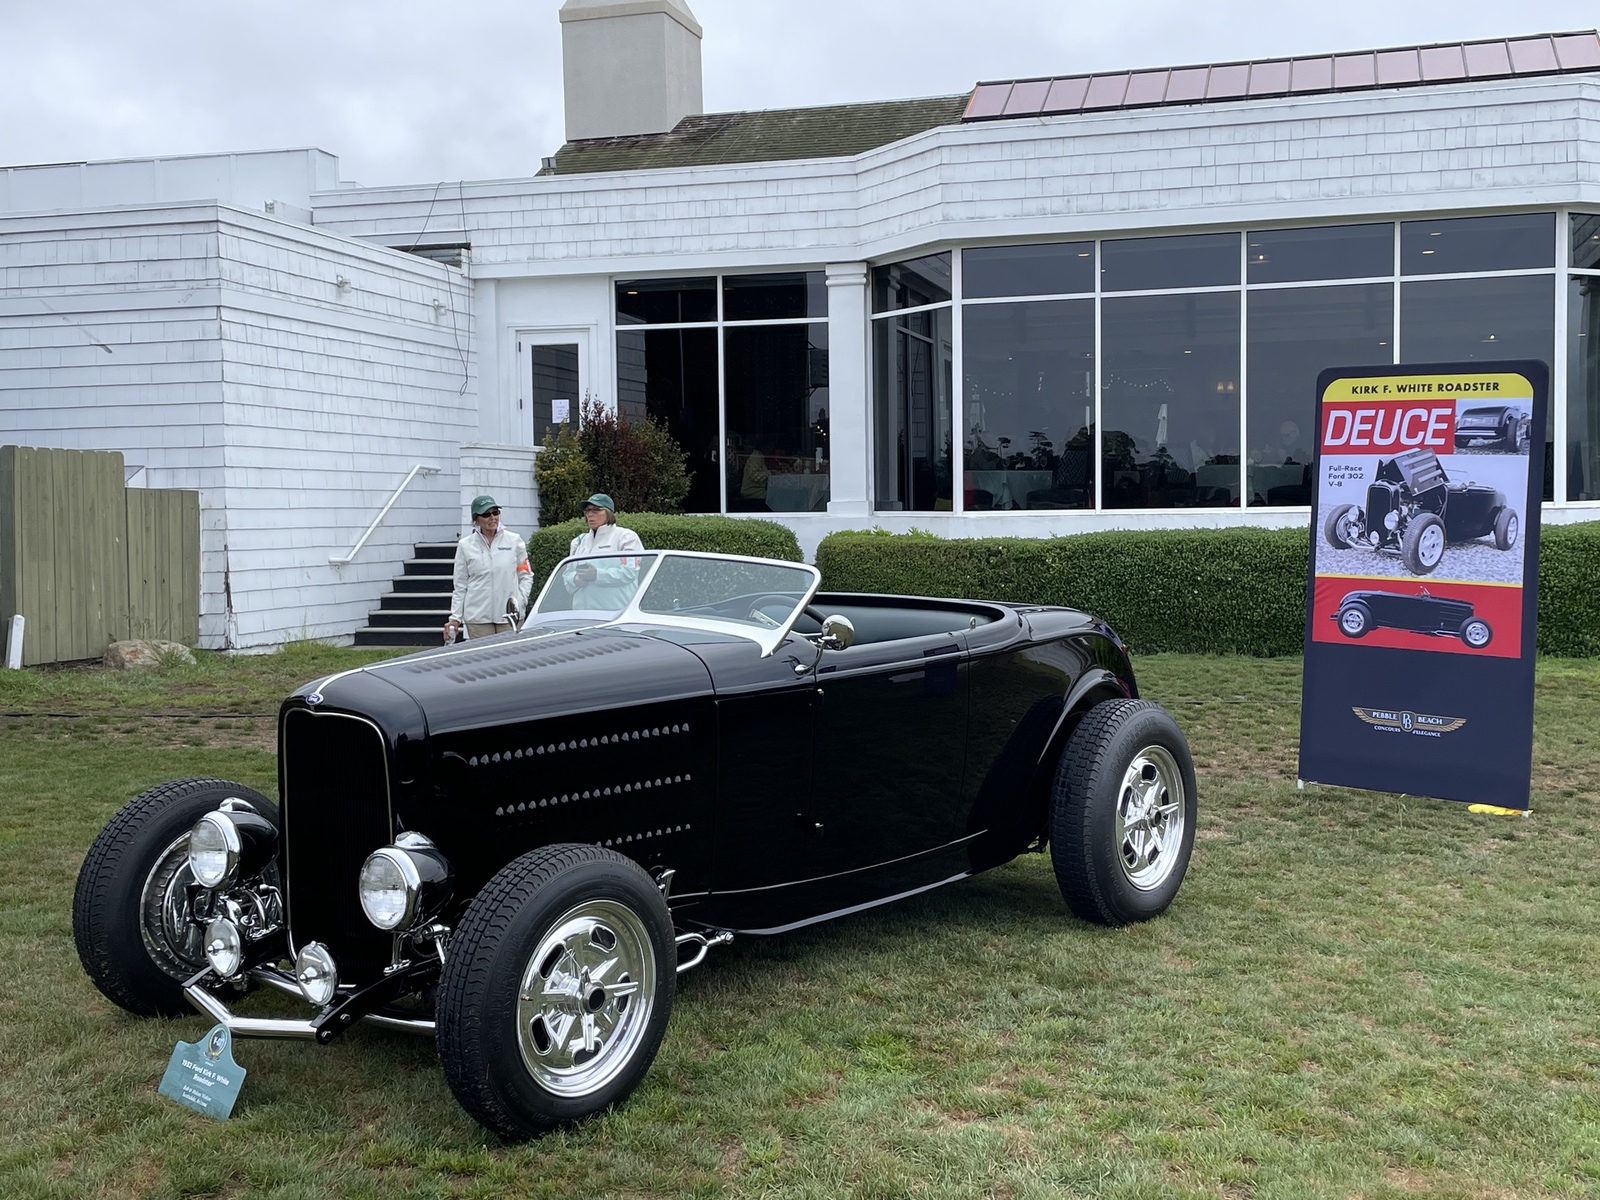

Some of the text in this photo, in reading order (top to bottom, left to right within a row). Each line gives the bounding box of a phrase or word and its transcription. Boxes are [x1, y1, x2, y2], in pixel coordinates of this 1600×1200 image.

[1351, 382, 1501, 395] KIRK F. WHITE ROADSTER
[1323, 408, 1453, 446] DEUCE
[1372, 711, 1443, 725] PEBBLE BEACH
[1373, 725, 1401, 733] CONCOURS
[191, 1064, 204, 1074] Ford
[216, 1074, 230, 1086] White
